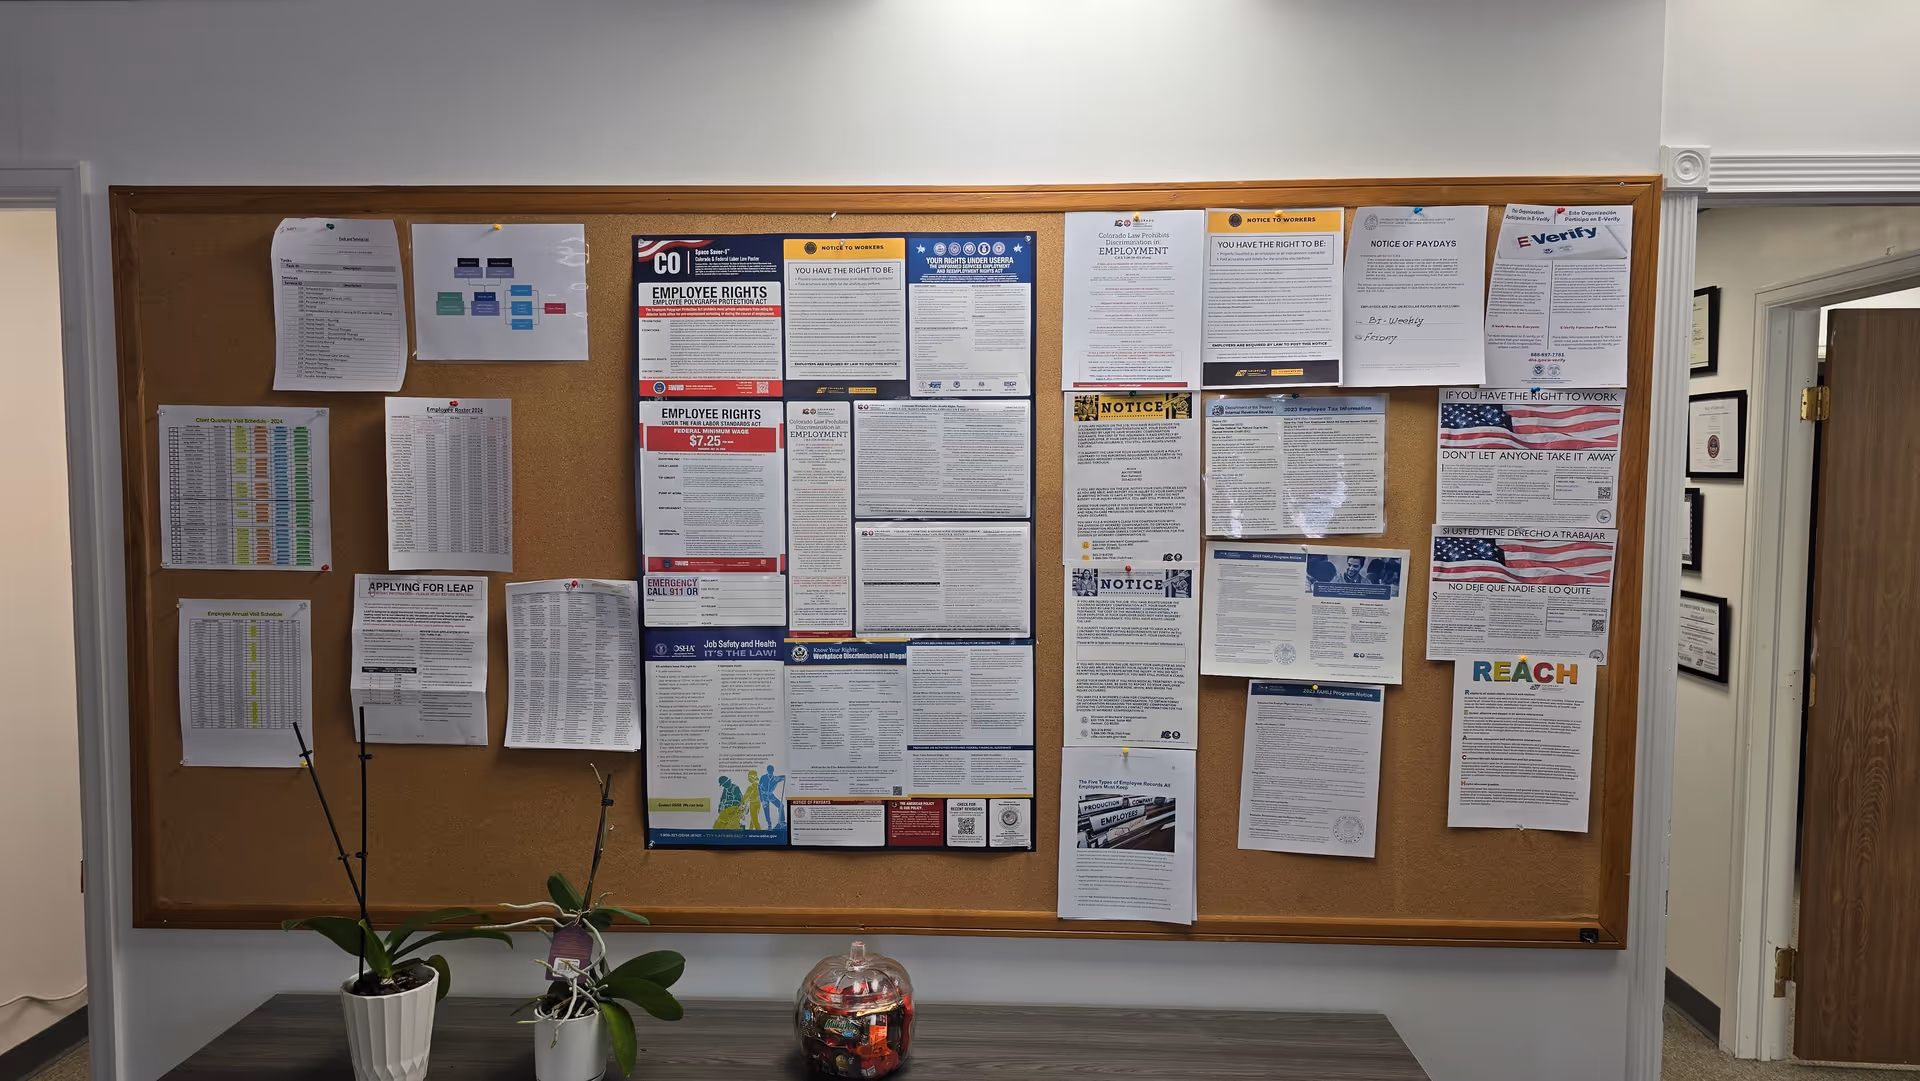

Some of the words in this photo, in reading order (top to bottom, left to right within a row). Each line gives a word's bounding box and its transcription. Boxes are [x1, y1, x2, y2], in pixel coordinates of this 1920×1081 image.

[1099, 247, 1168, 255] EMPLOYMENT
[654, 252, 680, 274] CO
[653, 287, 717, 298] EMPLOYEE
[722, 286, 767, 298] RIGHTS
[1456, 392, 1477, 400] YOU
[1480, 392, 1506, 400] HAVE
[1509, 392, 1528, 400] THE
[1566, 393, 1581, 401] TO
[1582, 393, 1617, 401] WORK
[1101, 401, 1163, 413] NOTICE
[662, 409, 718, 419] EMPLOYEE
[722, 409, 761, 419] RIGHTS
[690, 435, 721, 447] $7.25
[1442, 451, 1476, 459] DON'T
[1479, 451, 1496, 460] LET
[1500, 452, 1544, 461] ANYONE
[1547, 453, 1571, 461] TAKE
[1573, 453, 1583, 461] IT
[1587, 453, 1616, 462] AWAY
[369, 582, 420, 592] APPLYING
[423, 583, 444, 592] FOR
[447, 584, 474, 592] LEAP
[647, 579, 697, 587] EMERGENCY
[1101, 579, 1163, 590] NOTICE
[1466, 584, 1484, 592] DEJE
[1487, 584, 1505, 592] QUE
[718, 640, 739, 649] Safety
[1473, 661, 1578, 684] REACH
[1084, 800, 1120, 811] PRODUCTION
[1100, 810, 1138, 826] EMPLOYEES
